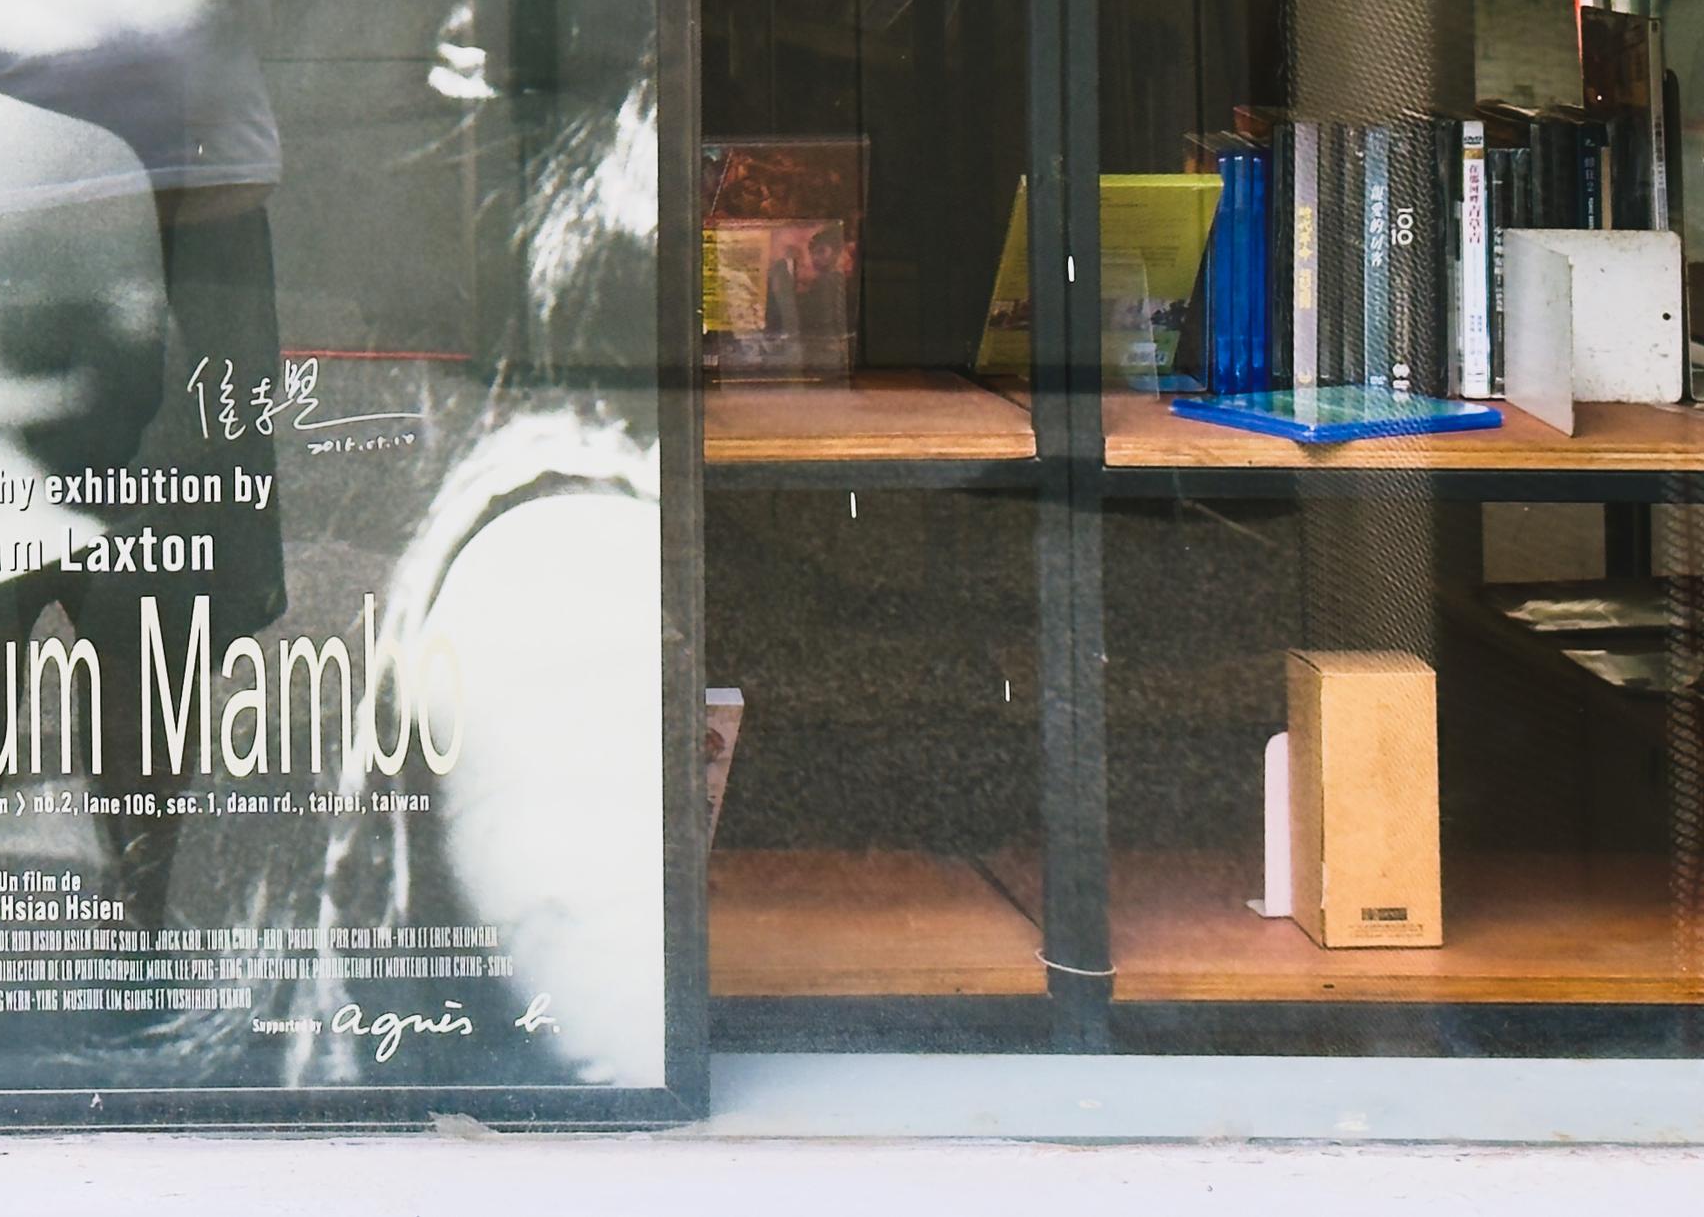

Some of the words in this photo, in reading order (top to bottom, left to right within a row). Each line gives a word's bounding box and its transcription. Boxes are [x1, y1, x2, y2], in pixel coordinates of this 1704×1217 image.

[44, 467, 222, 506] exhibition
[234, 466, 273, 510] by
[60, 526, 216, 573] Laxton
[140, 592, 464, 779] Mambo
[84, 791, 120, 814] lane
[124, 793, 162, 818] 106,
[166, 797, 203, 814] sec.
[226, 791, 269, 813] daan
[309, 790, 367, 816] taipei,
[371, 790, 431, 812] taiwan
[22, 870, 57, 892] film
[61, 870, 82, 892] de
[0, 894, 60, 921] Hsiao
[65, 894, 125, 921] Hsien
[155, 929, 180, 951] JACK
[252, 1018, 309, 1035] Supported
